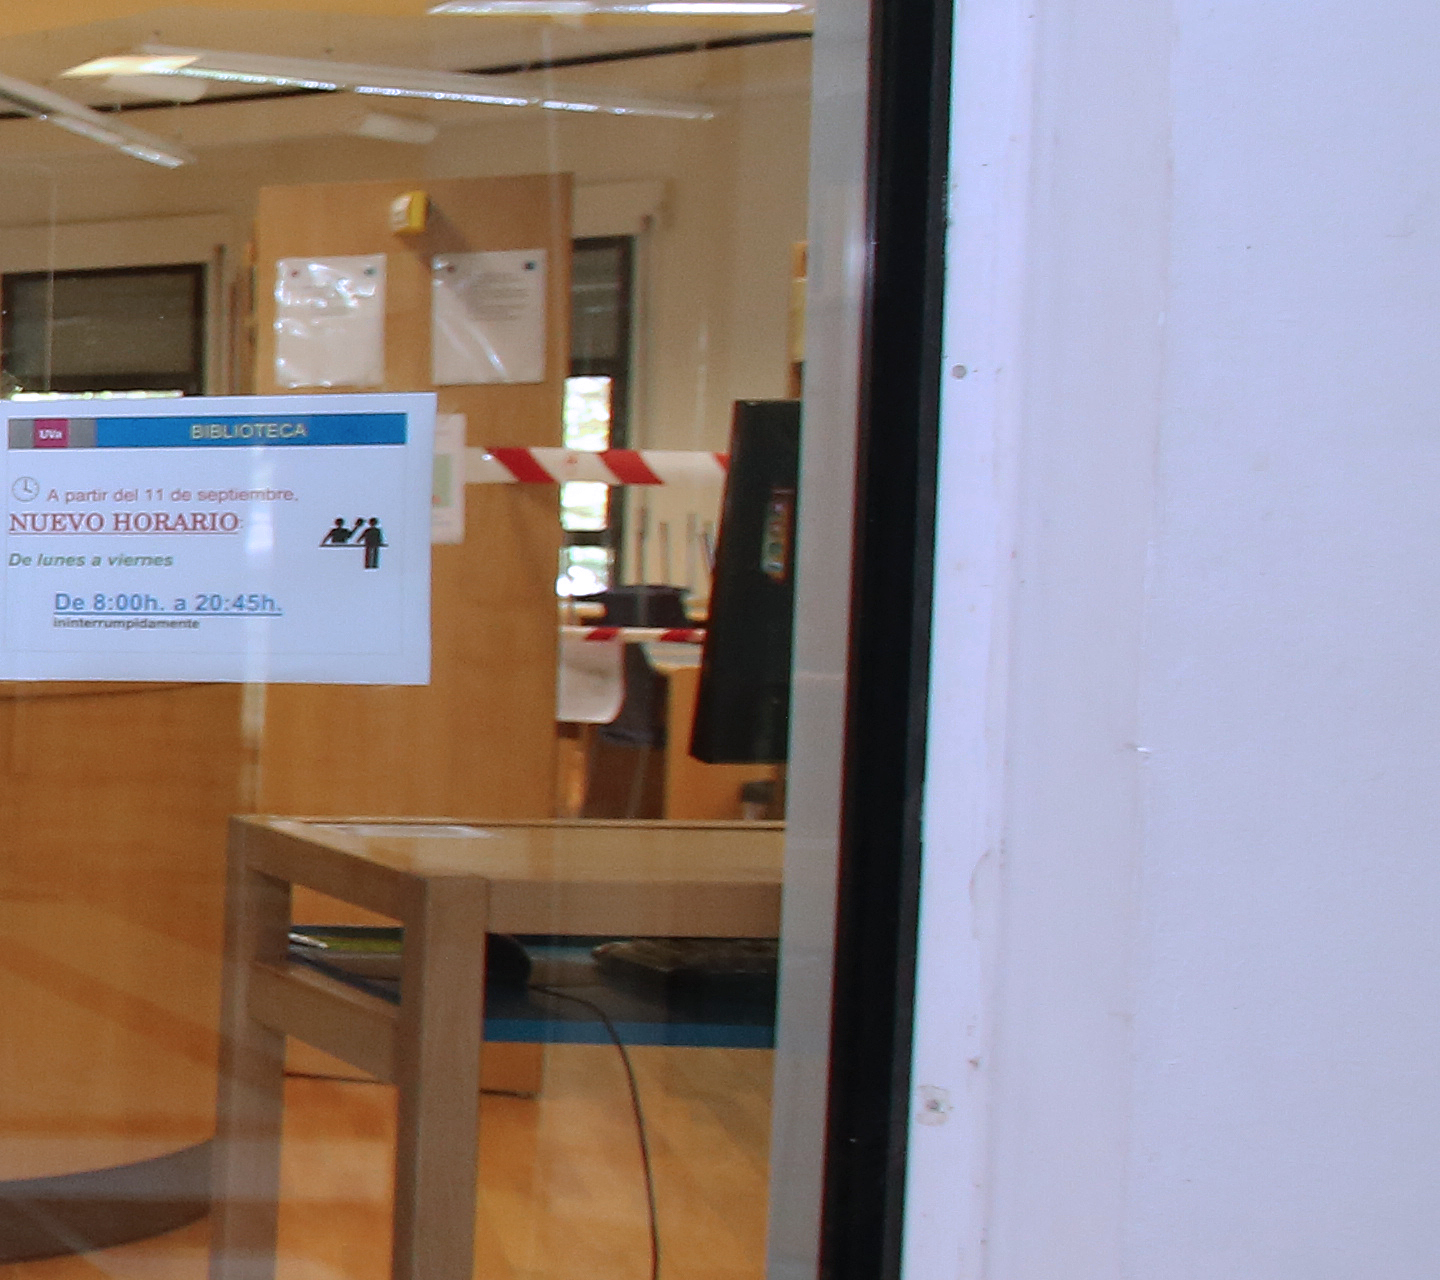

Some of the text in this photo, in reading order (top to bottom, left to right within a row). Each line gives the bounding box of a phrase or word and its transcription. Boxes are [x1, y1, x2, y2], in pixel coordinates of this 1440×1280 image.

[191, 422, 308, 440] BIBLIOTECA
[46, 489, 59, 502] A
[65, 488, 109, 505] partir
[113, 488, 139, 502] del
[145, 488, 164, 502] 11
[170, 488, 192, 502] de
[9, 512, 105, 532] NUEVO
[8, 553, 174, 567] De lunes a viernes
[54, 593, 85, 611] De
[174, 597, 188, 611] a
